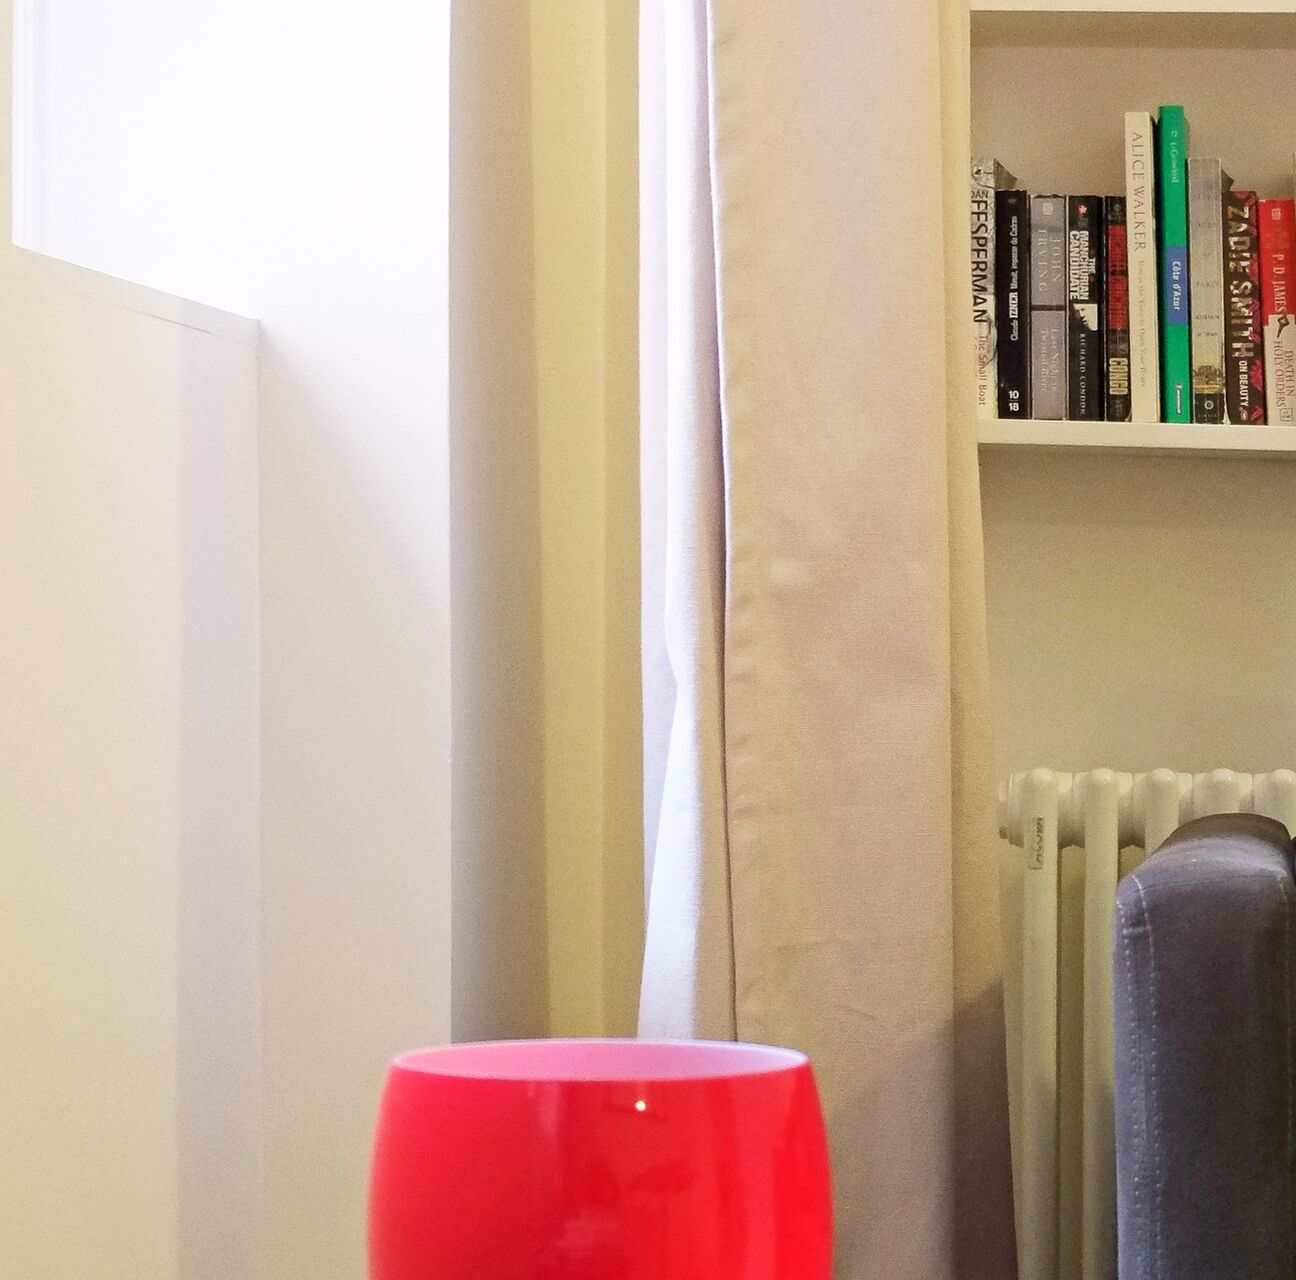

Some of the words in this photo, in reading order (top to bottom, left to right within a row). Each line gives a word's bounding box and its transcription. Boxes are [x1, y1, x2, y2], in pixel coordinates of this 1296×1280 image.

[1132, 132, 1144, 181] ALICE
[1134, 186, 1146, 253] WALKER
[1228, 206, 1250, 272] ZADIE
[971, 200, 989, 323] FESPERMAN
[1038, 229, 1050, 293] IRVING
[1051, 239, 1062, 284] JOHN
[1069, 231, 1080, 300] CANDIDATE
[1079, 231, 1089, 300] MANCHURIAN
[1088, 257, 1096, 274] THE
[1271, 253, 1285, 263] P.
[1272, 267, 1286, 279] D.
[1009, 292, 1018, 319] IZNER
[1272, 281, 1287, 312] JAMES
[1231, 281, 1254, 358] SMITH
[979, 335, 988, 351] The
[1273, 341, 1284, 367] HOLY
[979, 353, 988, 380] Small
[1109, 358, 1128, 396] CONGO
[1239, 361, 1248, 371] ON
[1284, 350, 1295, 378] DEATH
[978, 384, 988, 406] Boat
[1240, 374, 1249, 407] BEAUTY
[1275, 370, 1287, 407] ORDERS
[1285, 383, 1296, 396] IN
